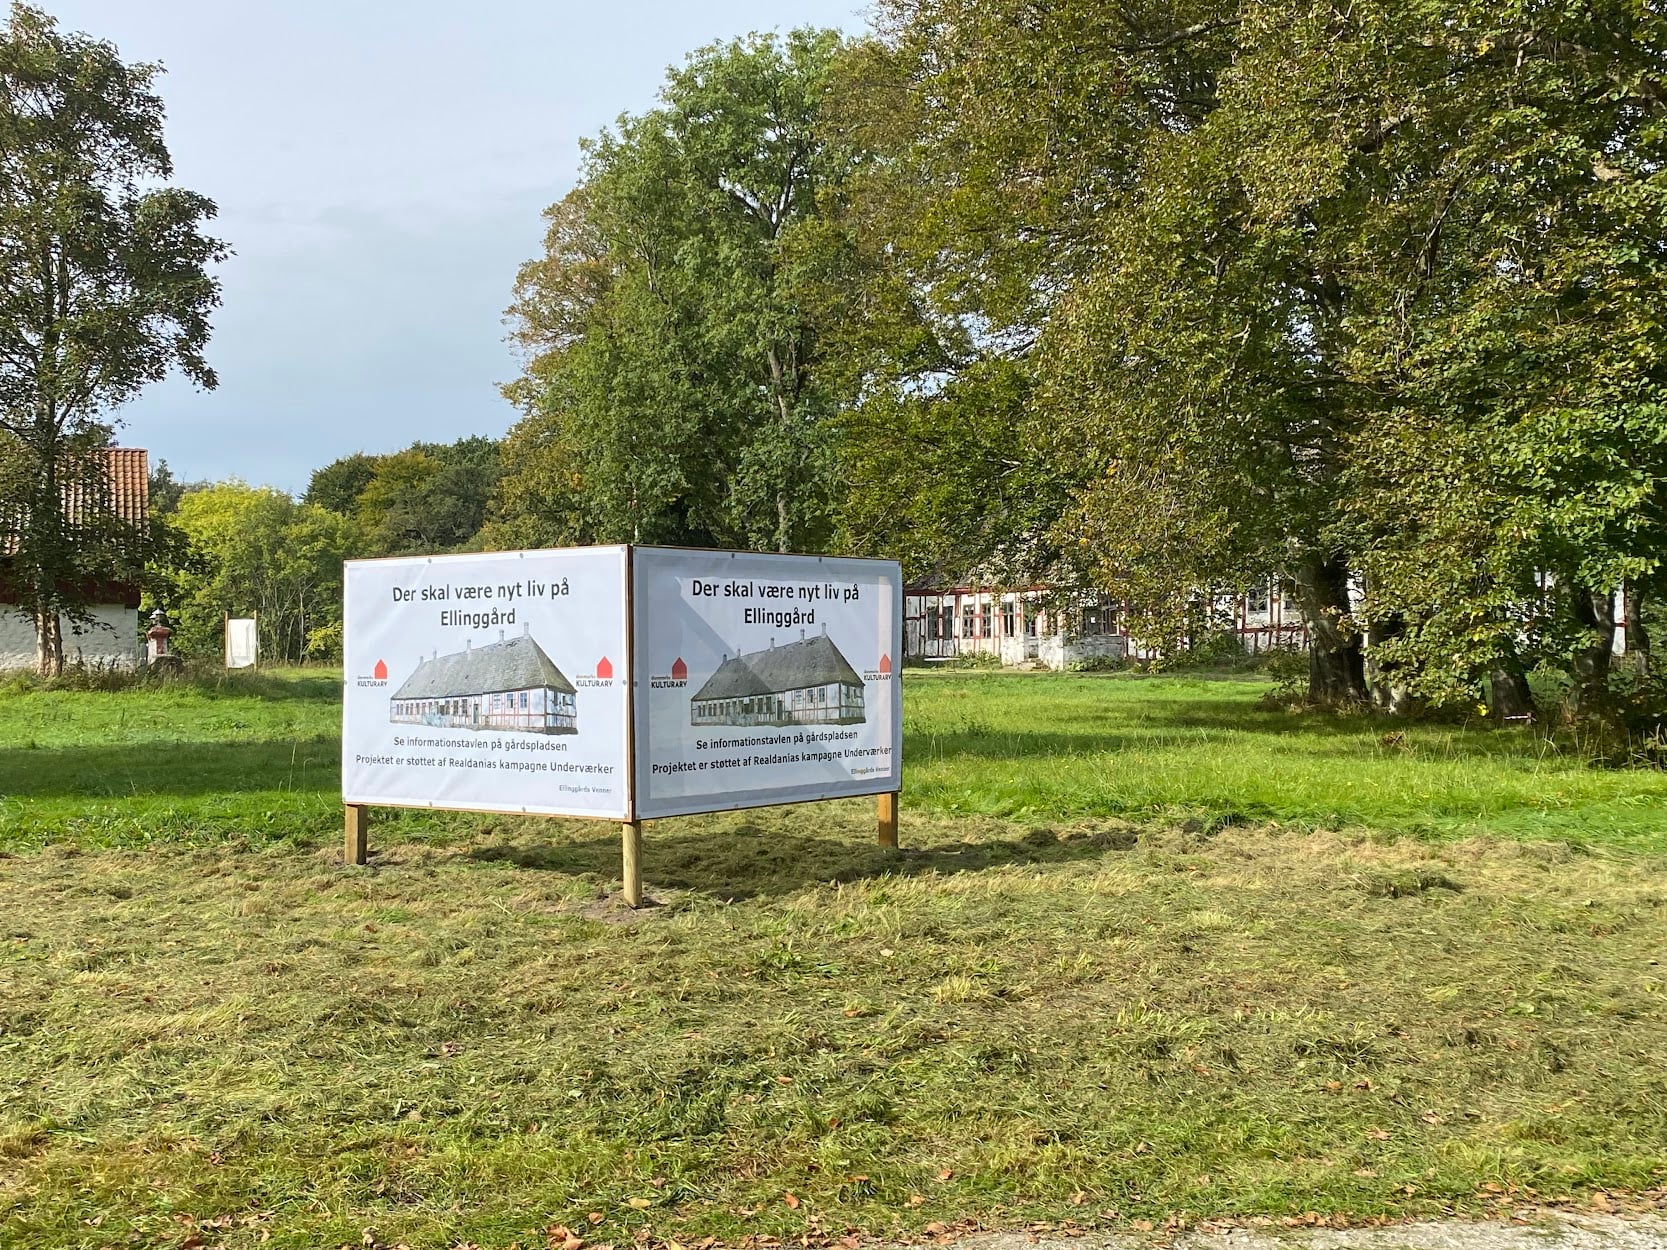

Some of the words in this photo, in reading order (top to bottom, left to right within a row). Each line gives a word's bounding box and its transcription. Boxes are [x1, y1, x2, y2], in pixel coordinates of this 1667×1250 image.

[393, 586, 416, 602] Der
[421, 584, 450, 600] skal
[455, 584, 493, 599] være
[498, 582, 522, 600] nyt
[527, 580, 545, 597] liv
[551, 577, 569, 599] på
[692, 580, 719, 597] Der
[724, 581, 753, 598] skal
[758, 585, 794, 599] være
[798, 583, 820, 602] nyt
[824, 584, 839, 600] liv
[843, 585, 859, 603] på
[440, 607, 516, 629] Ellinggård
[744, 608, 815, 628] Ellinggård
[394, 736, 405, 746] Se
[407, 736, 488, 749] informationstavlen
[491, 738, 502, 752] på
[505, 736, 568, 753] gårdspladsen
[696, 740, 708, 750] Se
[710, 734, 791, 750] informationstavlen
[793, 732, 804, 745] på
[806, 730, 858, 745] gårdspladsen
[355, 754, 394, 766] Projektet
[396, 757, 405, 765] er
[406, 757, 436, 767] støttet
[438, 757, 447, 767] af
[449, 757, 497, 769] Realdanias
[500, 759, 548, 774] kampagne
[550, 762, 614, 775] Underværker
[652, 760, 697, 775] Projektet
[699, 761, 708, 770] er
[710, 758, 741, 769] støttet
[743, 756, 752, 766] af
[753, 753, 800, 766] Realdanias
[801, 748, 842, 762] kampagne
[844, 746, 892, 758] Underværker
